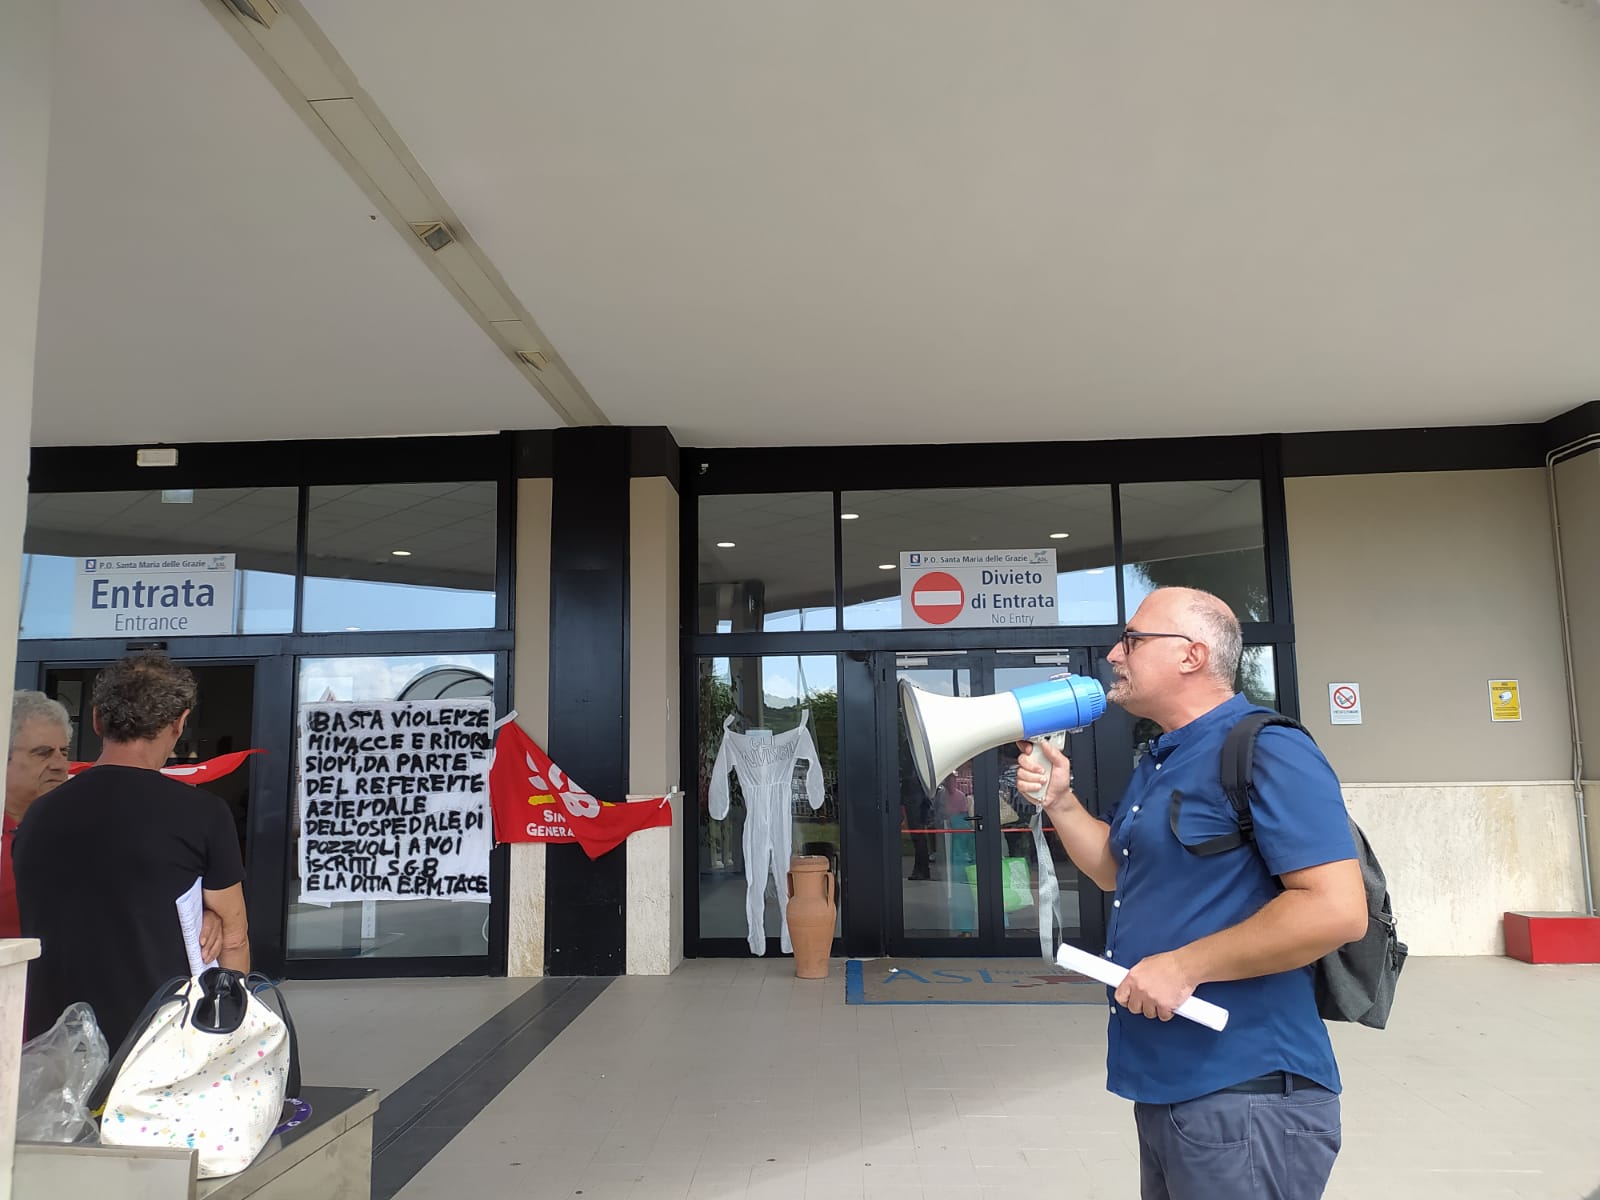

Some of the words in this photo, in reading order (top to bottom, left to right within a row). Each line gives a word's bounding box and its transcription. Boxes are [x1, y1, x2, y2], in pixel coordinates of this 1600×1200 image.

[116, 561, 137, 569] Santa
[138, 560, 161, 569] Maria
[162, 560, 180, 568] delle
[182, 559, 206, 568] Grazie
[962, 555, 983, 563] Maria
[985, 554, 1004, 562] delle
[1005, 554, 1028, 562] Grazie
[982, 569, 1042, 585] Divieto
[91, 579, 215, 609] Entrata
[971, 593, 986, 609] di
[993, 593, 1055, 609] Entrata
[115, 613, 188, 631] Entrance
[991, 613, 1006, 623] No
[1009, 612, 1035, 625] Entry
[309, 709, 385, 732] BASTA
[411, 733, 426, 749] E
[396, 752, 468, 773] PARTE
[306, 776, 349, 797] DEL
[356, 773, 485, 795] REFERENTE
[306, 810, 461, 836] DELL'OSPEDALE
[408, 836, 421, 856] A
[307, 874, 322, 892] E
[324, 872, 348, 890] LA
[883, 966, 1017, 984] ASL
